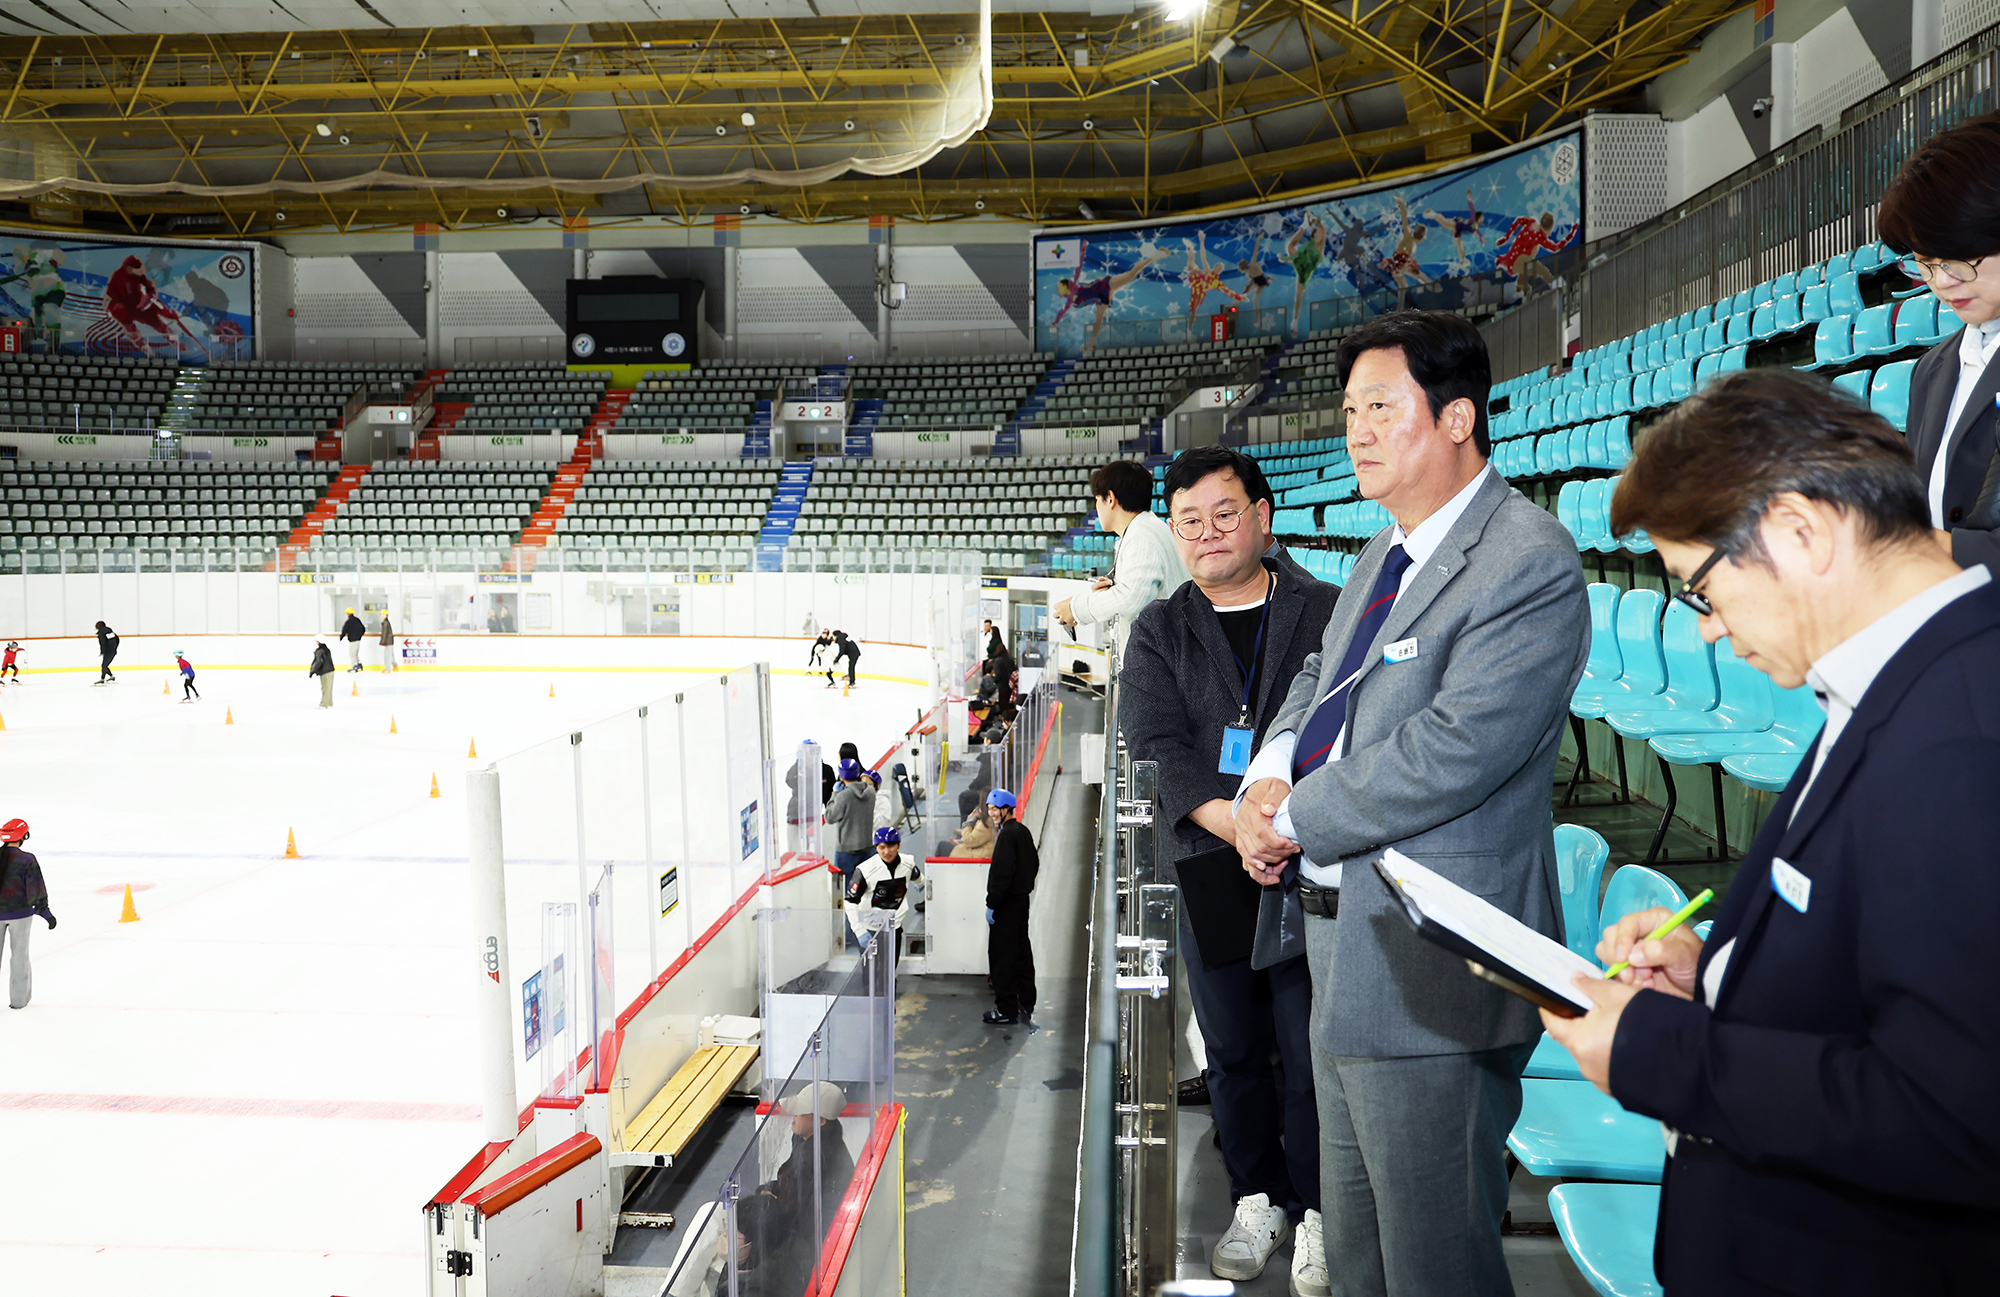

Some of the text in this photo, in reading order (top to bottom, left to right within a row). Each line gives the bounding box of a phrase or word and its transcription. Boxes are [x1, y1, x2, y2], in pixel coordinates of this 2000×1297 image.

[1214, 390, 1221, 403] 3
[388, 409, 394, 420] 1
[798, 405, 832, 417] 2 2
[711, 574, 732, 583] GAE
[483, 935, 499, 971] engo
